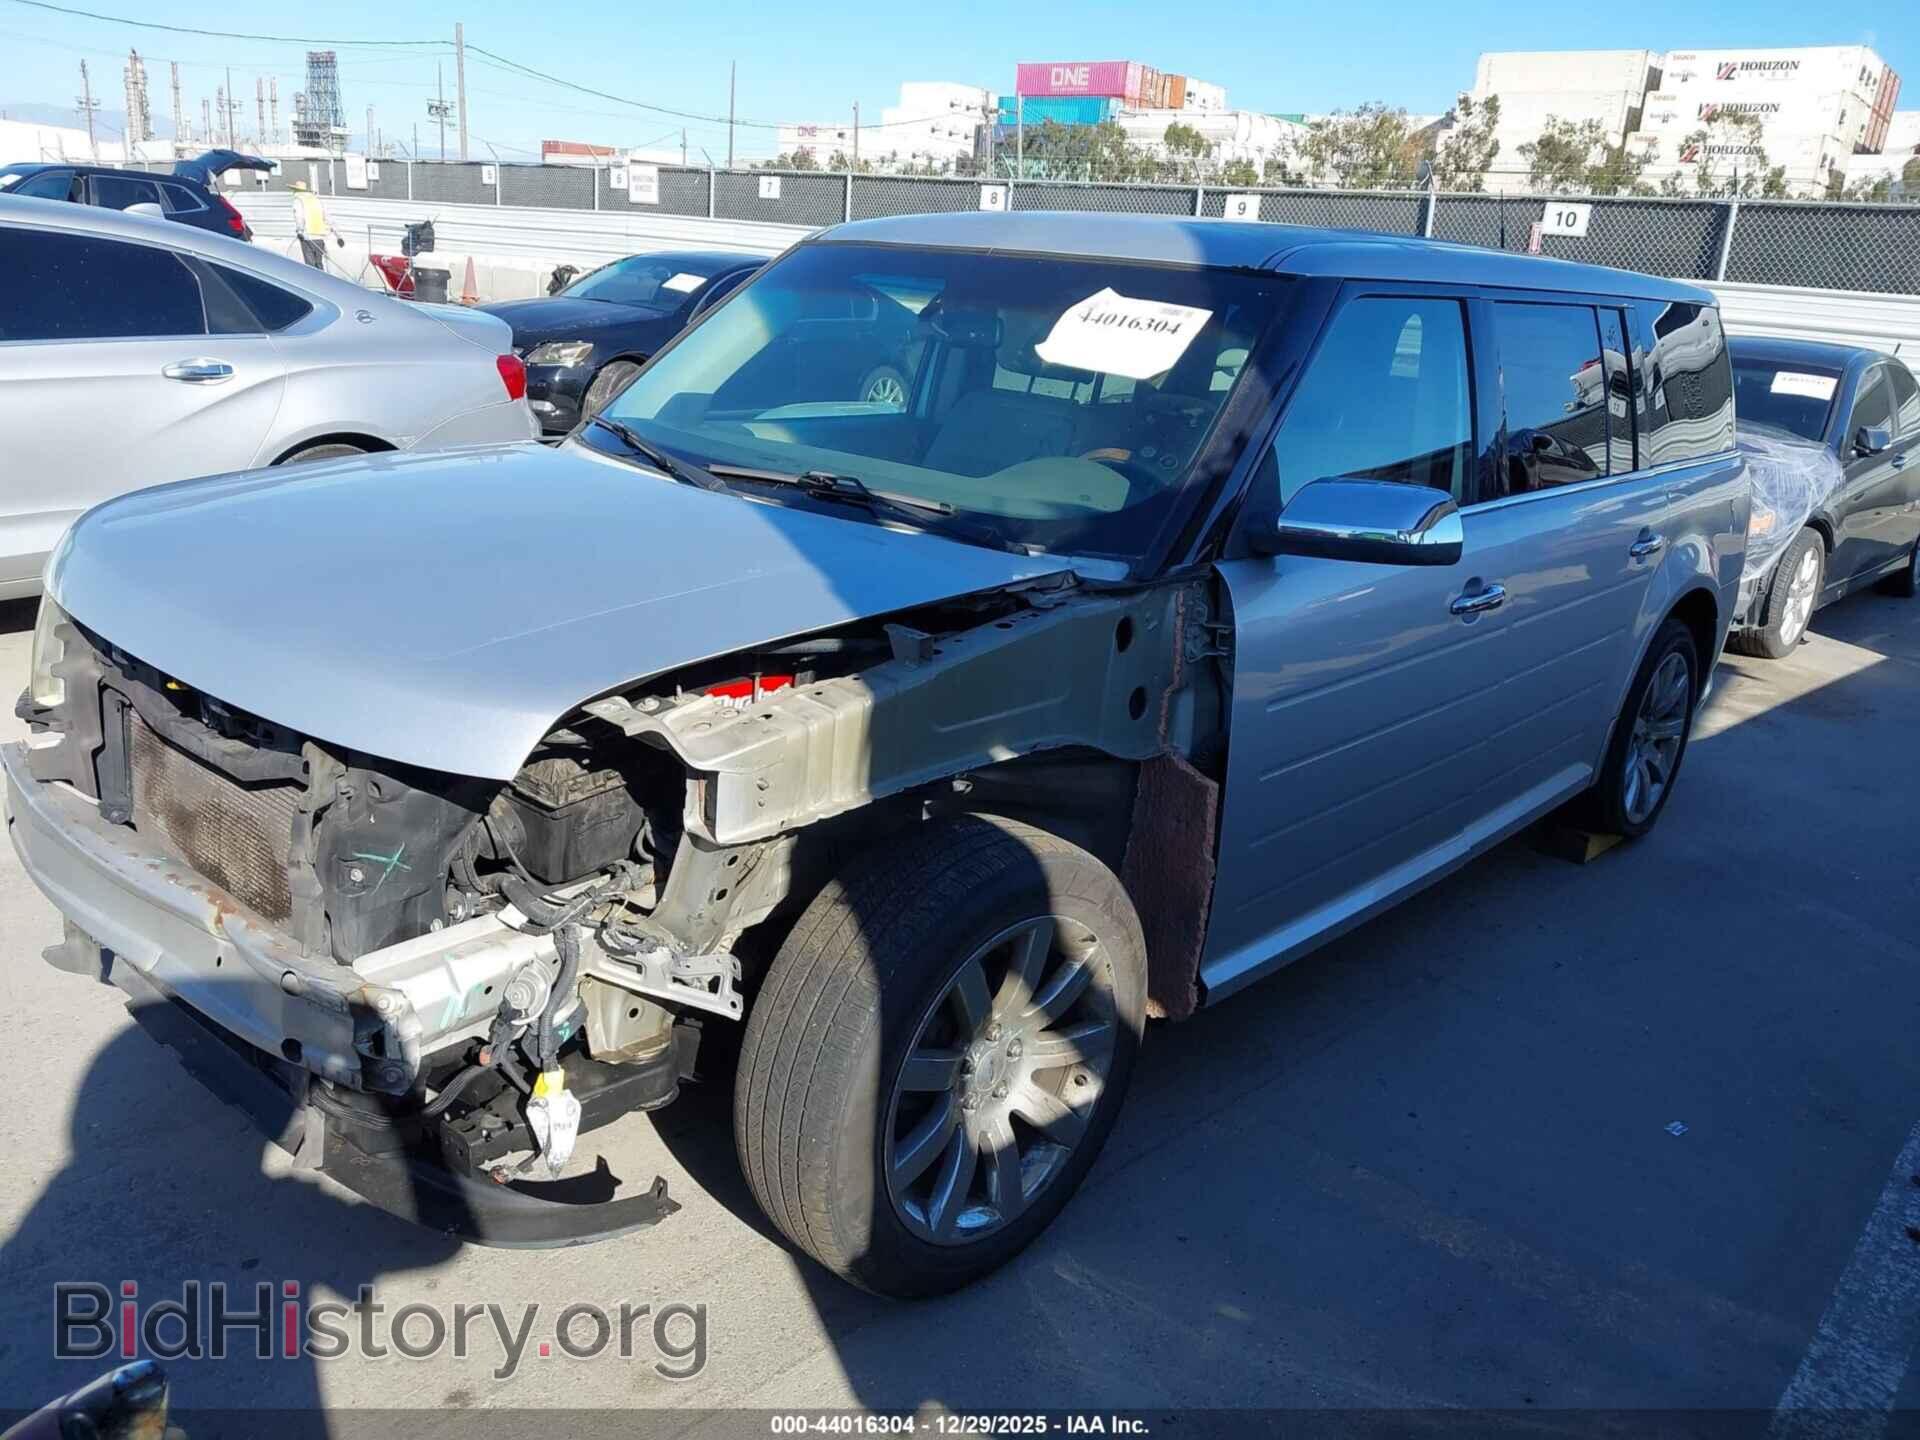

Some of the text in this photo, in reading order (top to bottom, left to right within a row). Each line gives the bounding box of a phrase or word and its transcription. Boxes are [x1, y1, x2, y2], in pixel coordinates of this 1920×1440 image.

[1740, 60, 1800, 71] HORIZON
[1050, 66, 1089, 86] ONE
[1721, 103, 1780, 113] HORIZON
[798, 126, 817, 137] ONE
[767, 181, 773, 193] 7
[990, 193, 998, 204] 8
[1238, 202, 1246, 215] 9
[1555, 211, 1577, 227] 10
[1079, 306, 1183, 335] 44016304
